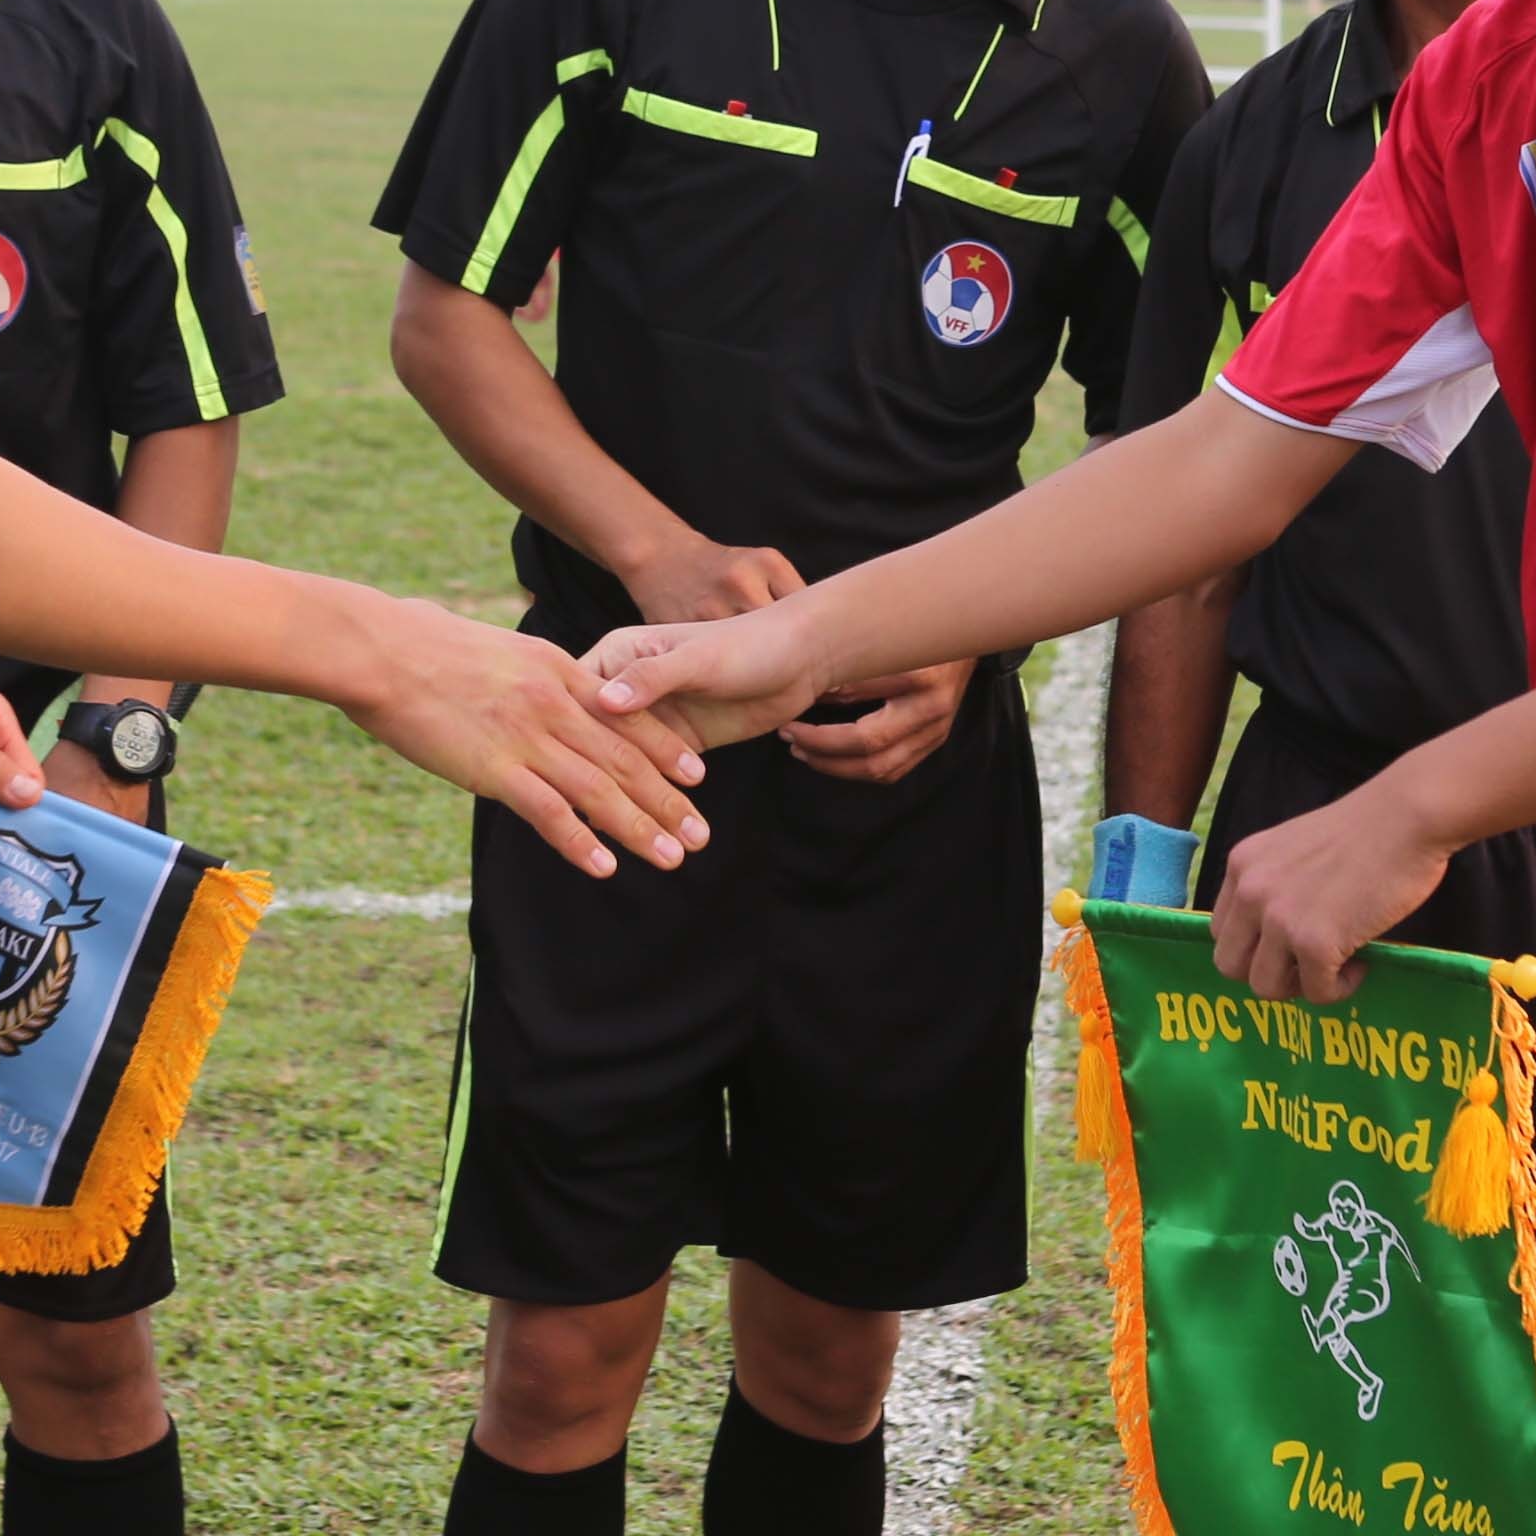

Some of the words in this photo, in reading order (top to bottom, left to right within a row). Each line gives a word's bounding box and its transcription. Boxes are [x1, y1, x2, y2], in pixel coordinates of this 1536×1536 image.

[945, 315, 970, 334] VFF
[1155, 992, 1243, 1053] HỌC
[1319, 1006, 1431, 1082] BÓNG
[1241, 1080, 1433, 1173] NutiFood
[1272, 1440, 1365, 1527] Thân
